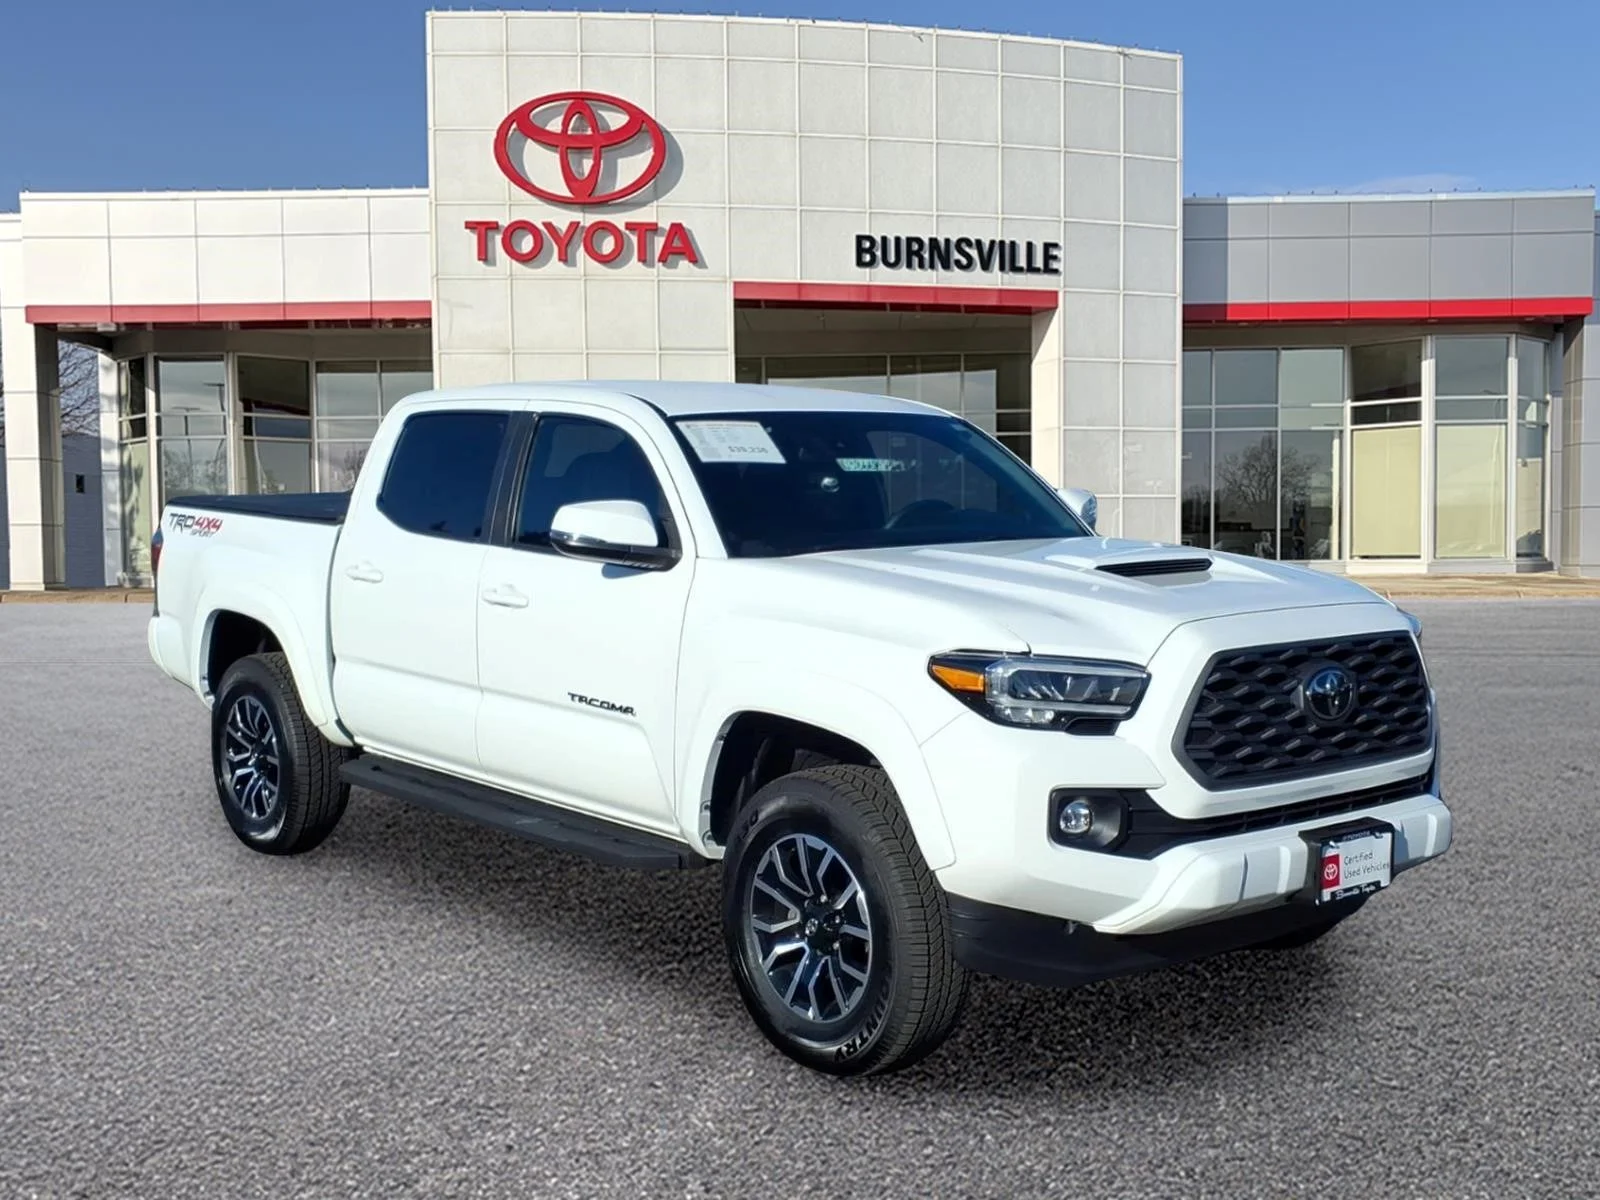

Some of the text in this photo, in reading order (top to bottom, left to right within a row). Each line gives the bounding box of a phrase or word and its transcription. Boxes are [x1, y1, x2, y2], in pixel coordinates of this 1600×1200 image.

[464, 220, 699, 263] TOYOTA
[855, 234, 1062, 275] BURNSVILLE
[170, 513, 195, 533] TRD
[567, 691, 637, 717] TACOMA
[1344, 851, 1374, 866] Certified
[1344, 861, 1390, 879] Used Vehicles
